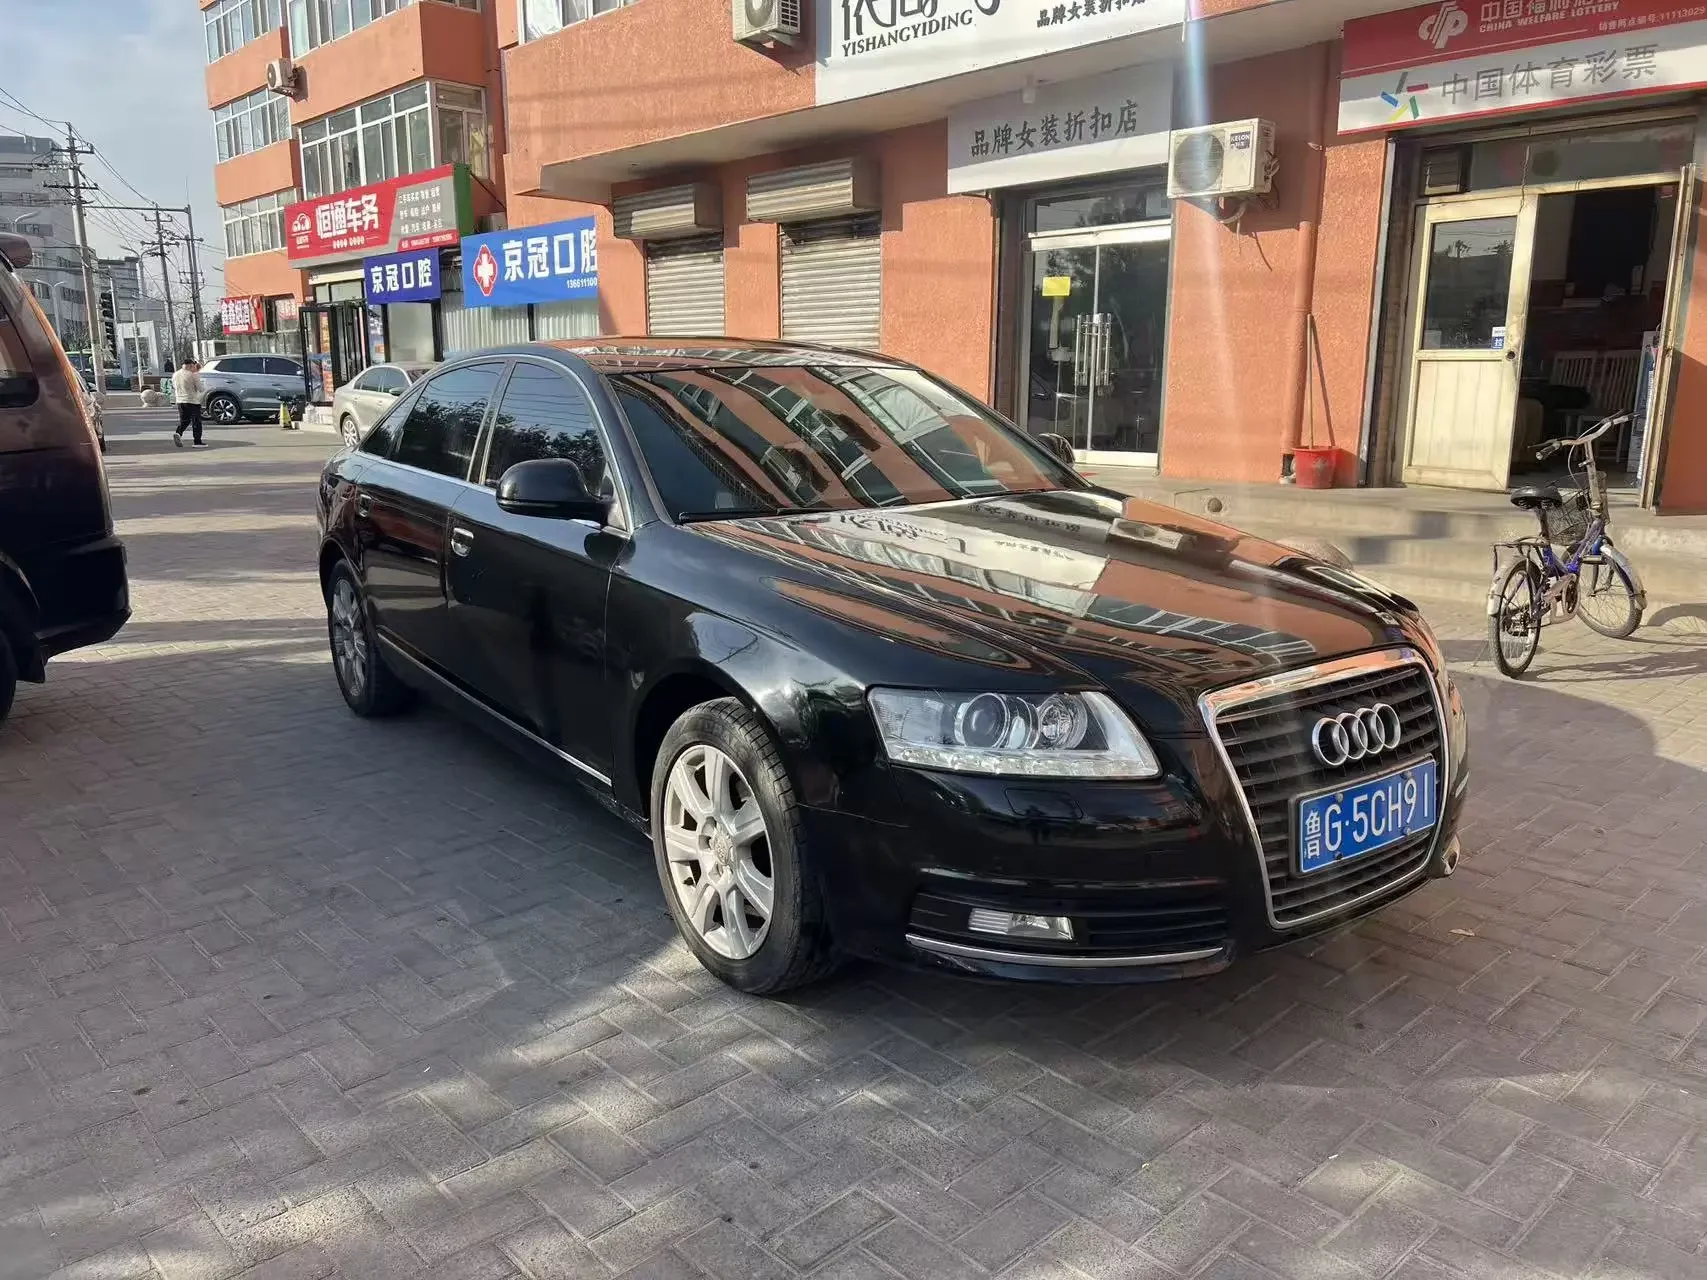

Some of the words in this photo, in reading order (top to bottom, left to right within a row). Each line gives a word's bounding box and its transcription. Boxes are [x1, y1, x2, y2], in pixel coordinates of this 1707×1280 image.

[842, 9, 973, 57] YISHANGYIDING
[1480, 20, 1512, 33] CHINA
[1518, 11, 1566, 26] WELFARE
[1572, 1, 1619, 17] LOTTERY
[1441, 43, 1658, 105] 中国体育彩票
[970, 100, 1139, 158] 品牌女装折扣店
[316, 193, 379, 240] 恒通车务
[370, 257, 433, 294] 京冠口腔
[1305, 772, 1429, 860] 鲁G·5CH91
